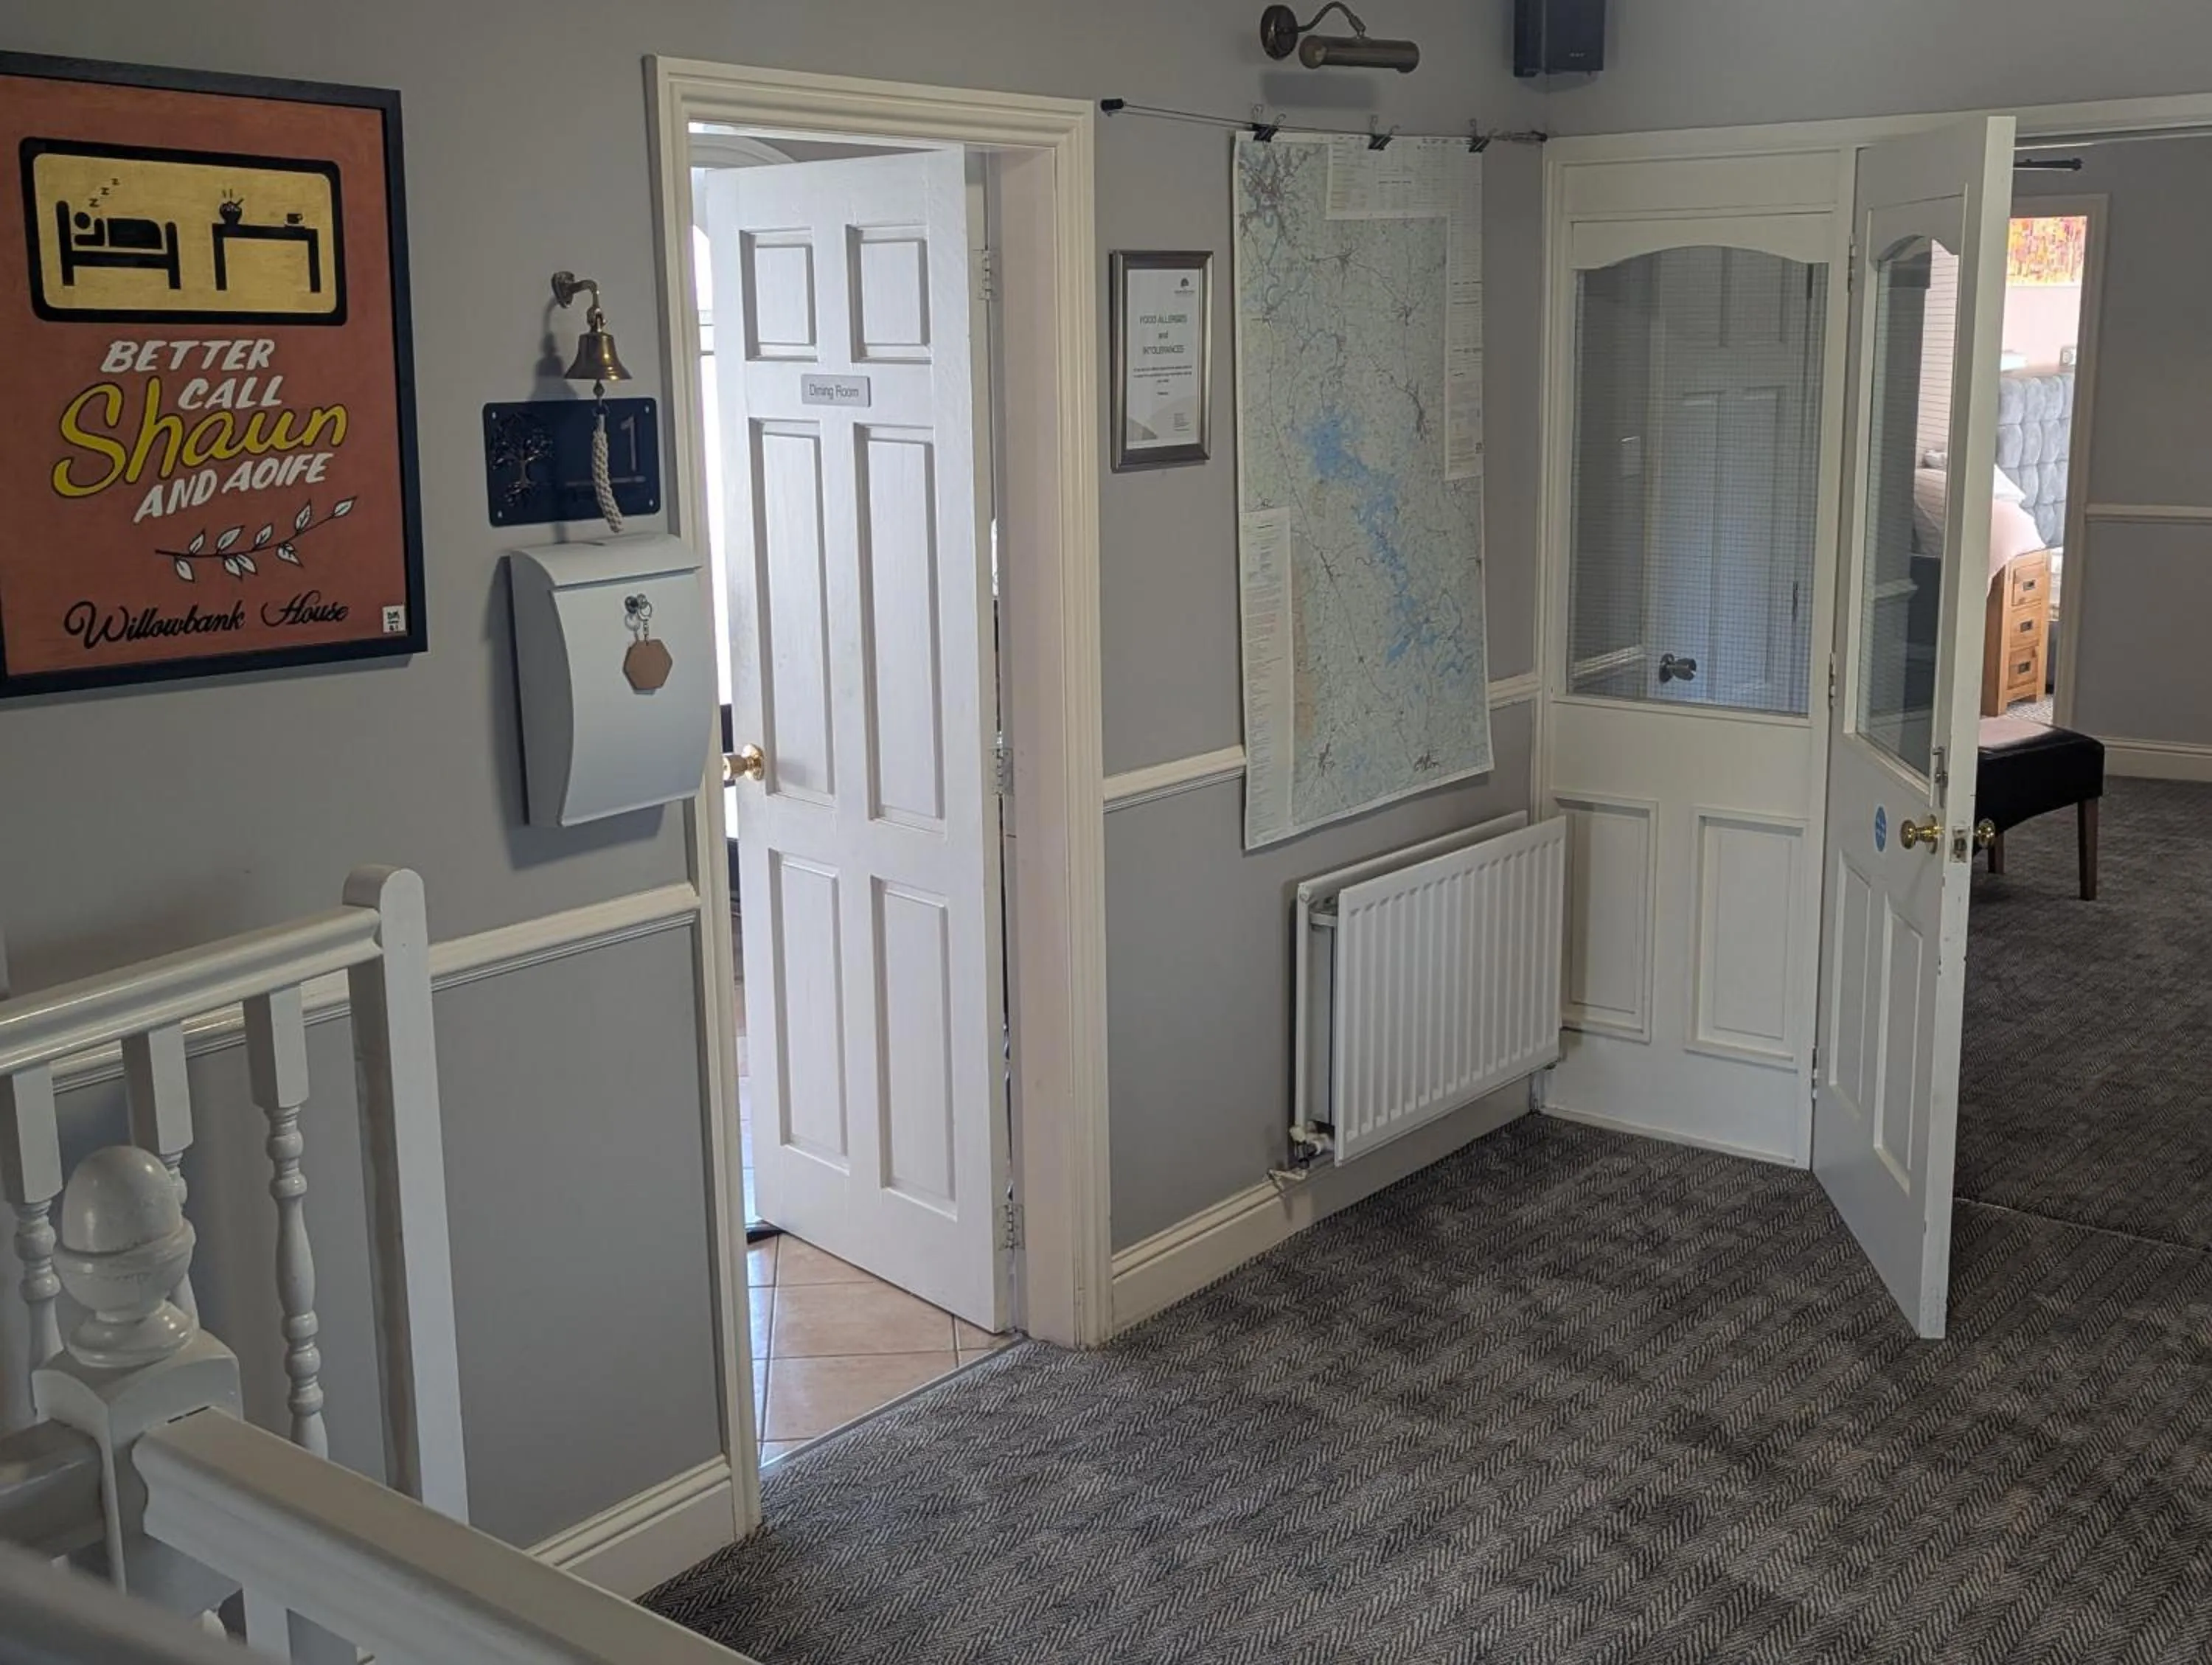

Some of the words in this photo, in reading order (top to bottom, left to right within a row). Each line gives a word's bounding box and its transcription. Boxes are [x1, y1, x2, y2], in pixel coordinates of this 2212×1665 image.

[100, 339, 275, 372] BETTER
[178, 375, 284, 409] CALL
[835, 384, 859, 398] Room
[52, 375, 348, 498] Shaun
[133, 469, 218, 524] AND
[221, 452, 334, 494] AOIFE
[64, 600, 245, 649] Willowbank
[260, 590, 350, 627] House
